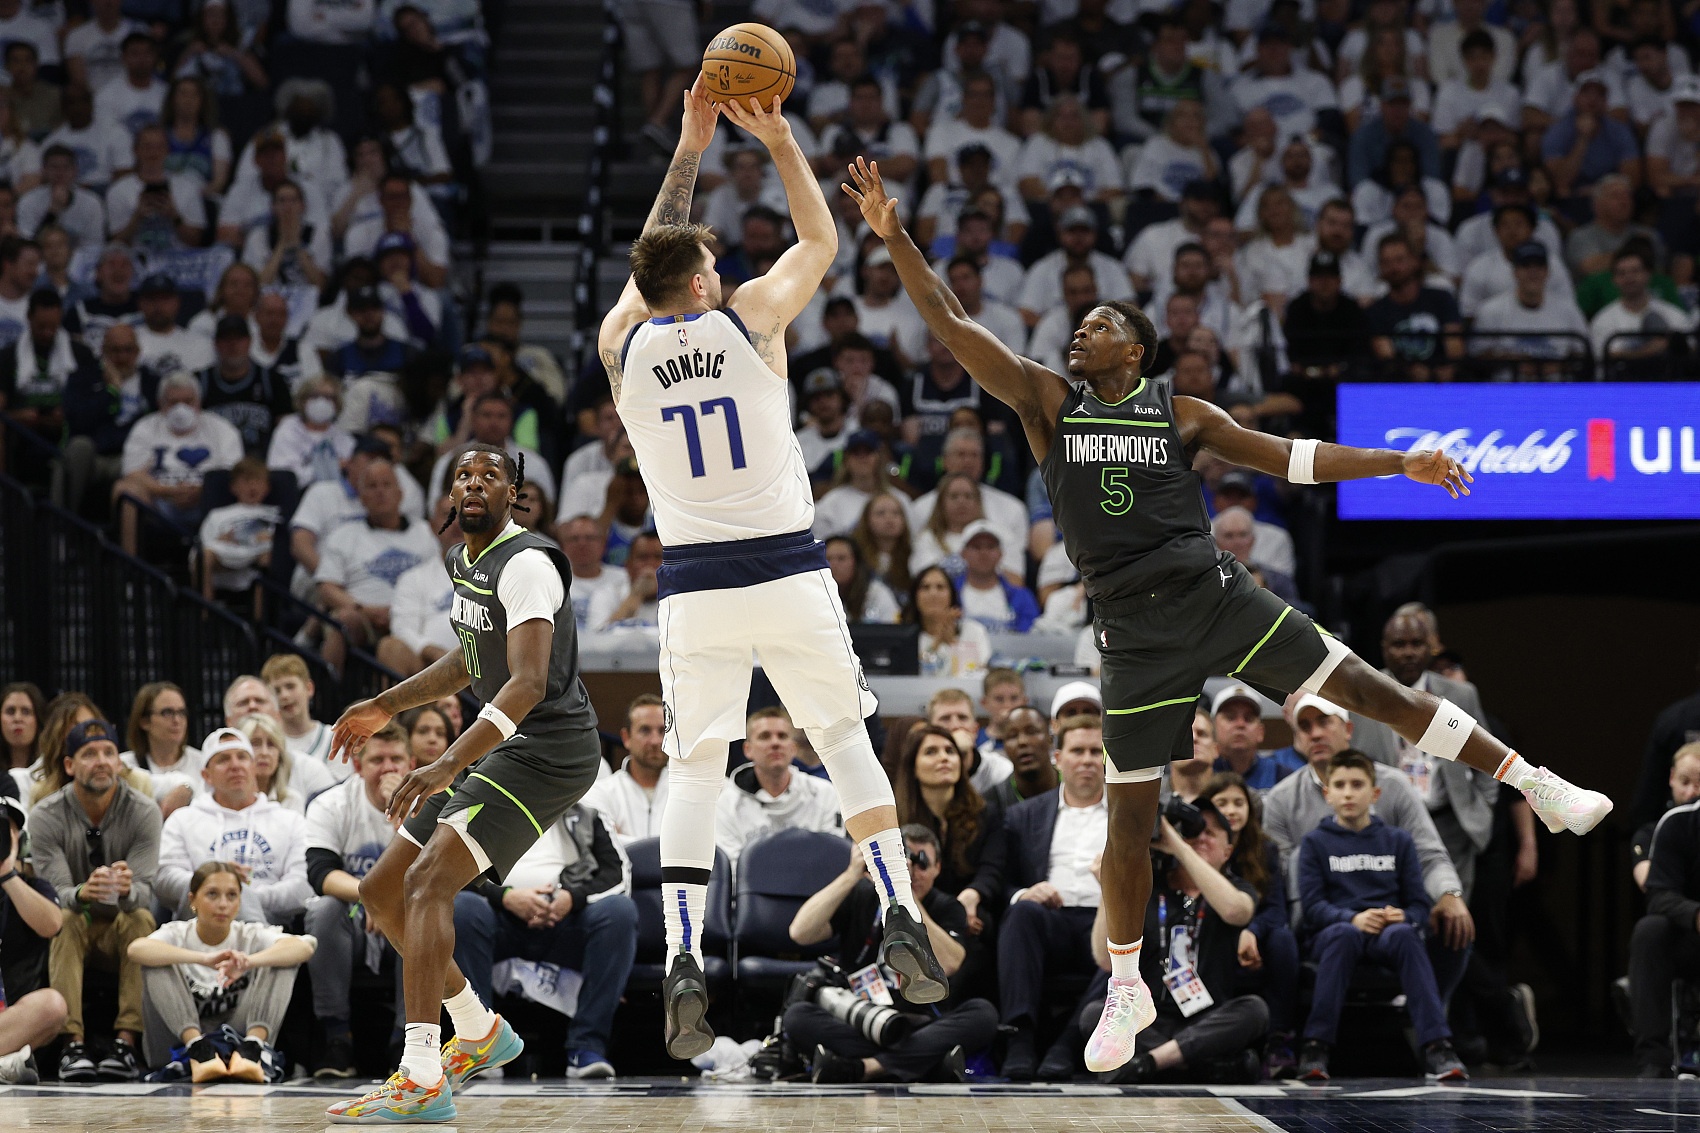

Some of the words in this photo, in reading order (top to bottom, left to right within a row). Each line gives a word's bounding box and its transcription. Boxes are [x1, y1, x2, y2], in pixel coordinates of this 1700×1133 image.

[708, 37, 762, 59] Wilson
[652, 348, 726, 389] DONČIĆ
[660, 396, 748, 479] 77
[1063, 434, 1168, 468] TIMBERWOLVES
[1100, 467, 1134, 516] 5
[458, 627, 481, 679] 11
[1447, 717, 1459, 730] 5
